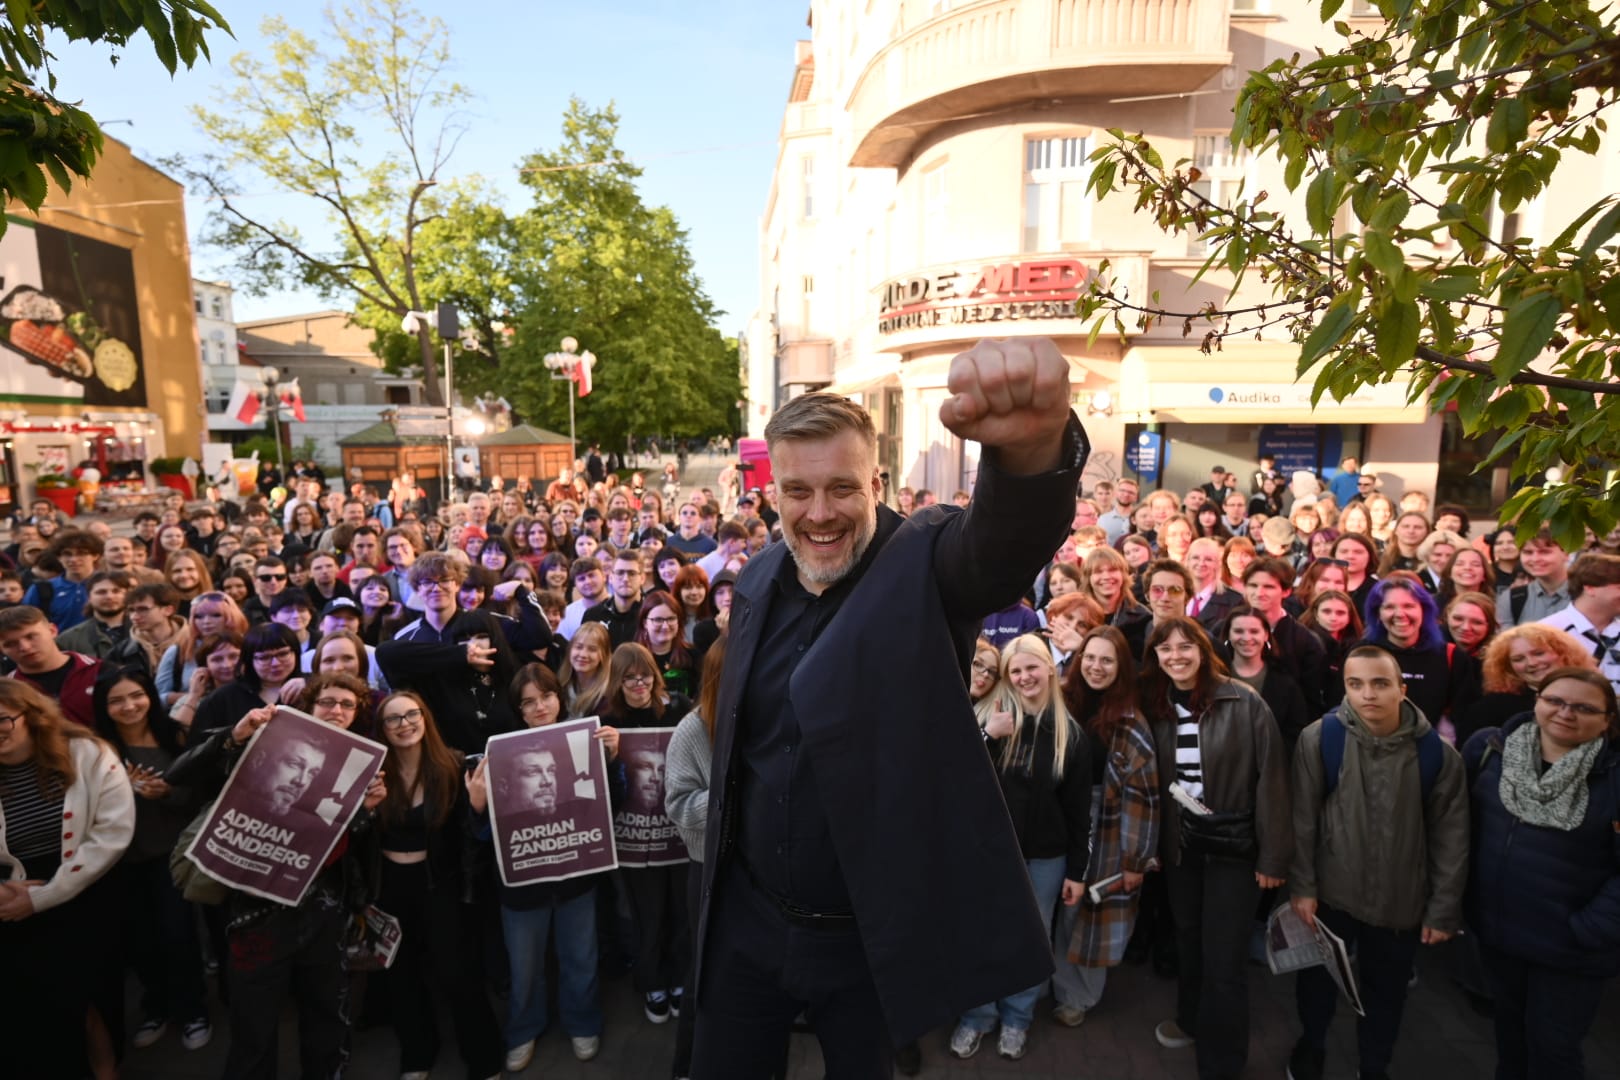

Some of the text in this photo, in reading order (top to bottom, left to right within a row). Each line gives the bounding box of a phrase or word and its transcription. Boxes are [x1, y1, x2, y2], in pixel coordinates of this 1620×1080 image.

[1228, 391, 1281, 404] Audika
[222, 807, 296, 846] ADRIAN
[509, 818, 575, 844] ADRIAN
[614, 811, 670, 828] ADRIAN
[614, 824, 681, 841] ZANDBER
[213, 820, 311, 870] ZANDBERG
[510, 828, 603, 858] ZANDBERG
